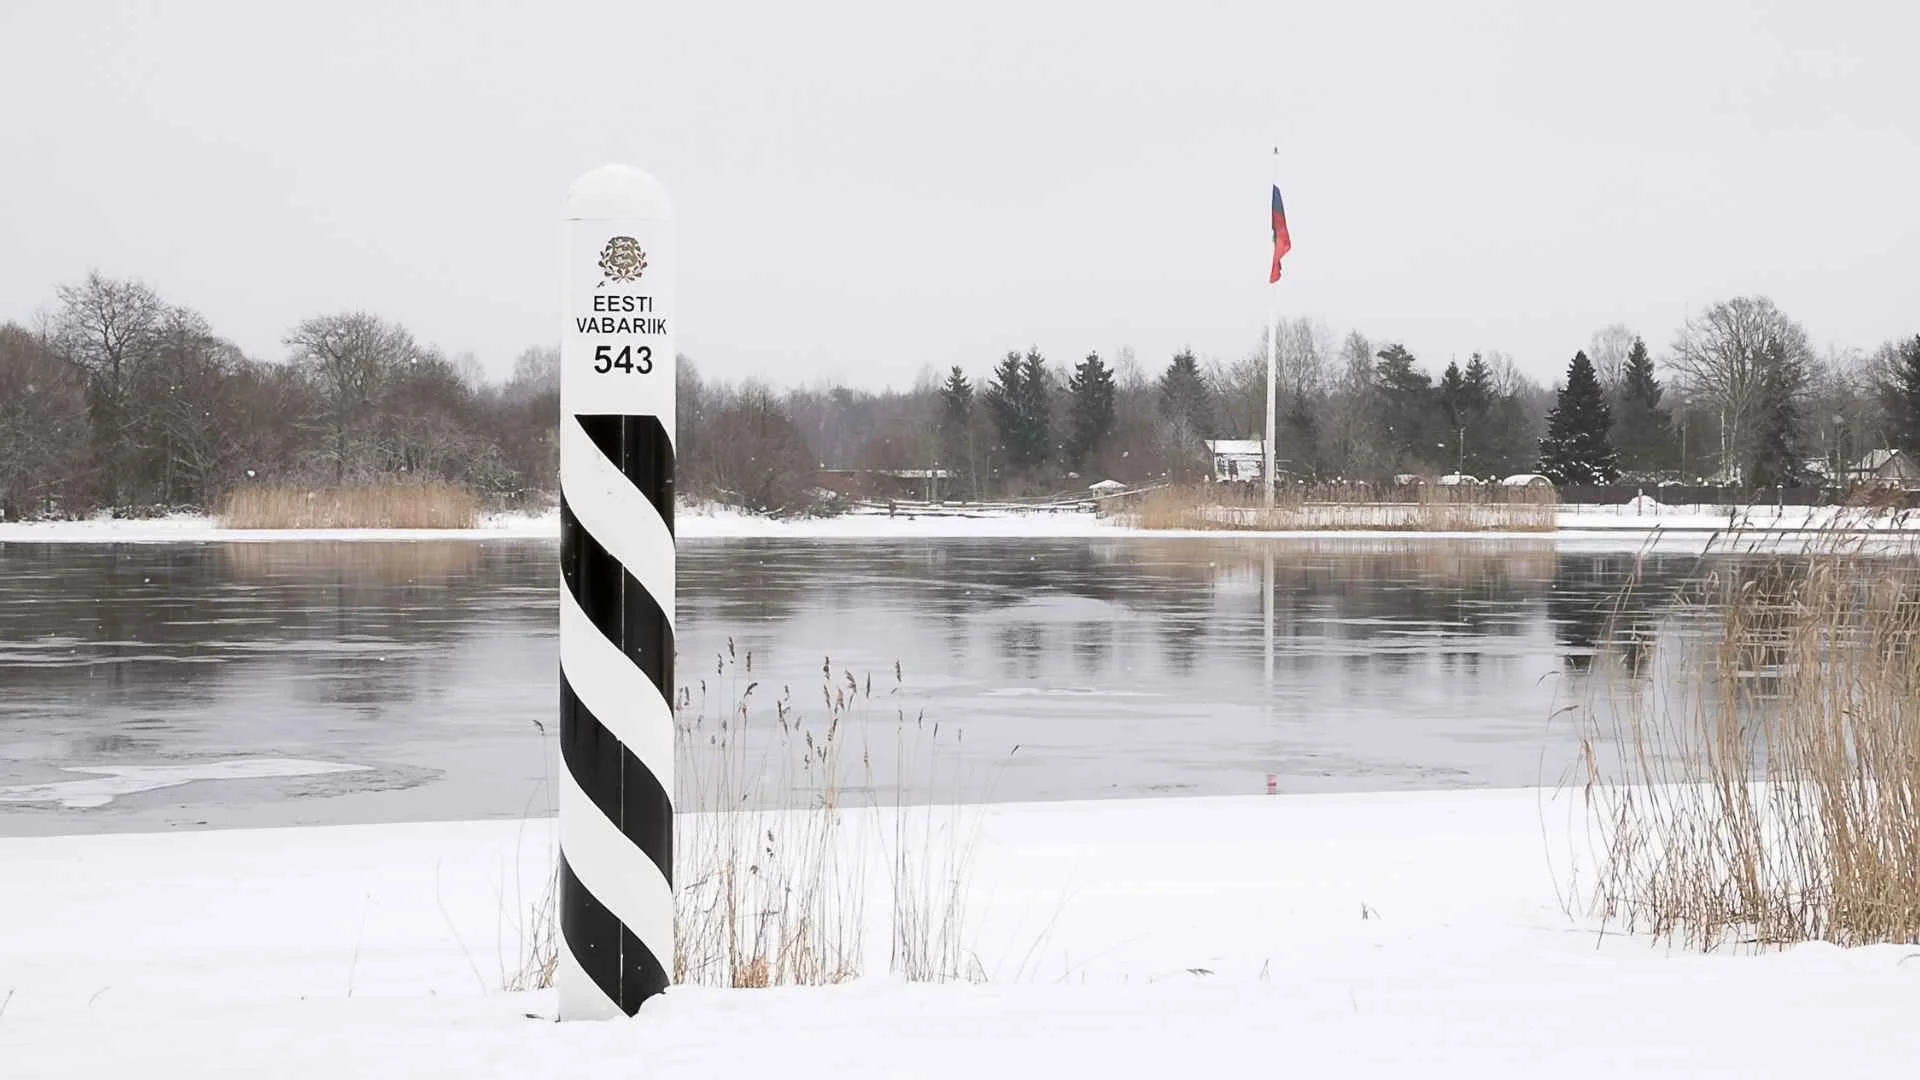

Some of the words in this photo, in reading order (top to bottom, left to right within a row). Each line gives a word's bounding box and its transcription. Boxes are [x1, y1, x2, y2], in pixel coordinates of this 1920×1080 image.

[593, 295, 653, 312] EESTI
[576, 317, 667, 335] VABARIIK
[593, 345, 653, 374] 543
